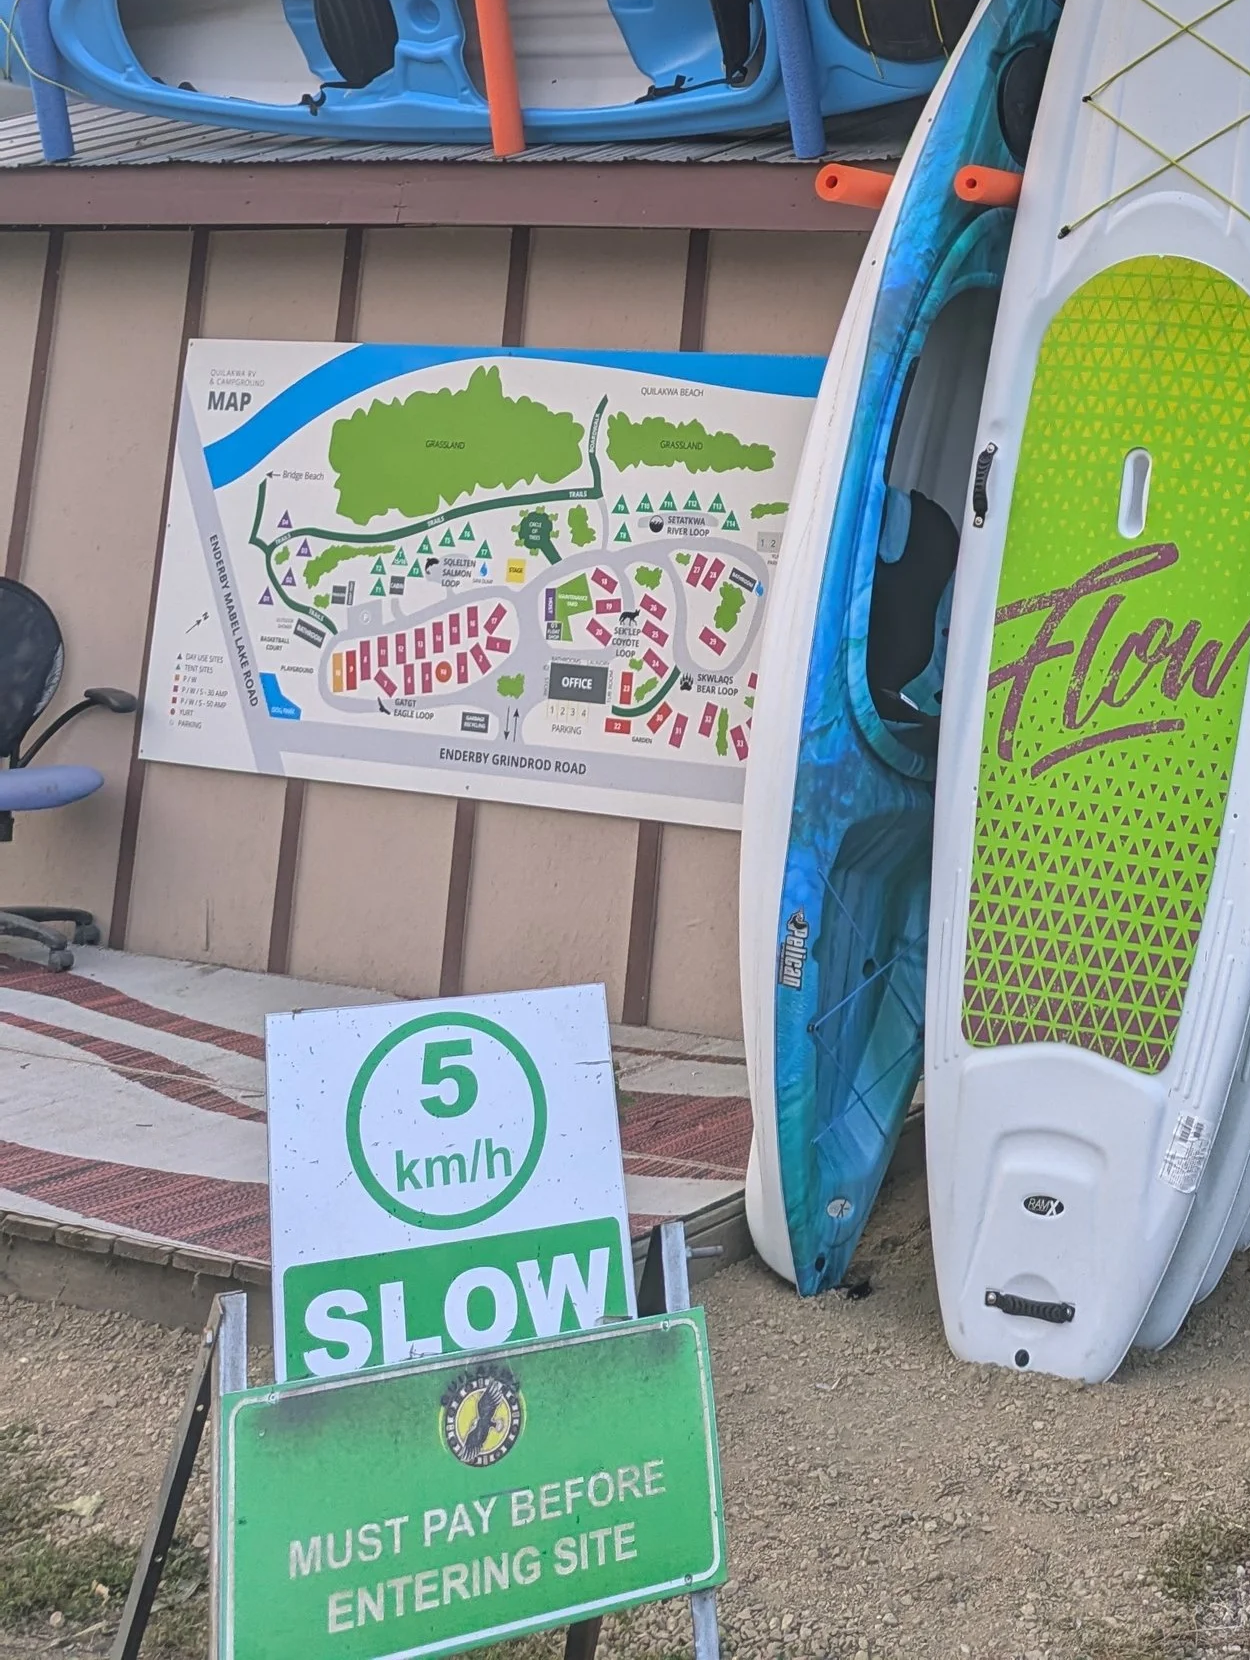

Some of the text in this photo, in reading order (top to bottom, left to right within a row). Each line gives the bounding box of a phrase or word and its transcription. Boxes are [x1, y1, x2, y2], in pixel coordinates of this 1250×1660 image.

[210, 369, 256, 378] QUILAKWA RV
[217, 378, 265, 387] CAMPGROUND
[641, 387, 704, 397] QUILAKWA BEACH
[207, 391, 252, 412] MAP
[589, 413, 600, 453] BOARDWALK
[426, 440, 465, 449] GRASSLAND
[660, 440, 703, 450] GRASSLAND
[282, 470, 324, 480] Bridge Beach
[569, 490, 587, 498] TRAILS
[427, 515, 445, 527] TRAILS
[668, 516, 705, 526] SETATKWA
[667, 527, 710, 537] RIVER LOOP
[443, 558, 476, 567] SQLELTEN
[442, 568, 472, 578] SALMON
[441, 579, 460, 588] LOOP
[210, 534, 259, 707] ENDERBY MABEL LAKE ROAD
[260, 635, 289, 644] BASKETBALL
[612, 638, 639, 647] COYOTE
[209, 655, 223, 663] SITES
[616, 650, 635, 658] LOOP
[185, 664, 198, 672] TENT
[281, 665, 314, 674] PLAYGROUND
[561, 676, 593, 690] OFFICE
[697, 674, 734, 684] SKWLAQS
[697, 685, 738, 696] BEAR LOOP
[395, 698, 416, 707] GATGT
[394, 709, 434, 720] EAGLE LOOP
[178, 720, 202, 729] PARKING
[552, 724, 582, 735] PARKING
[632, 736, 652, 744] GARDEN
[439, 748, 587, 775] ENDERBY GRINDROD ROAD
[783, 924, 808, 990] Pelican
[419, 1039, 479, 1119] 5
[395, 1137, 512, 1192] km/h
[303, 1246, 609, 1381] SLOW
[287, 1458, 667, 1581] MUST PAY BEFORE
[326, 1522, 638, 1634] ENTERING SITE
